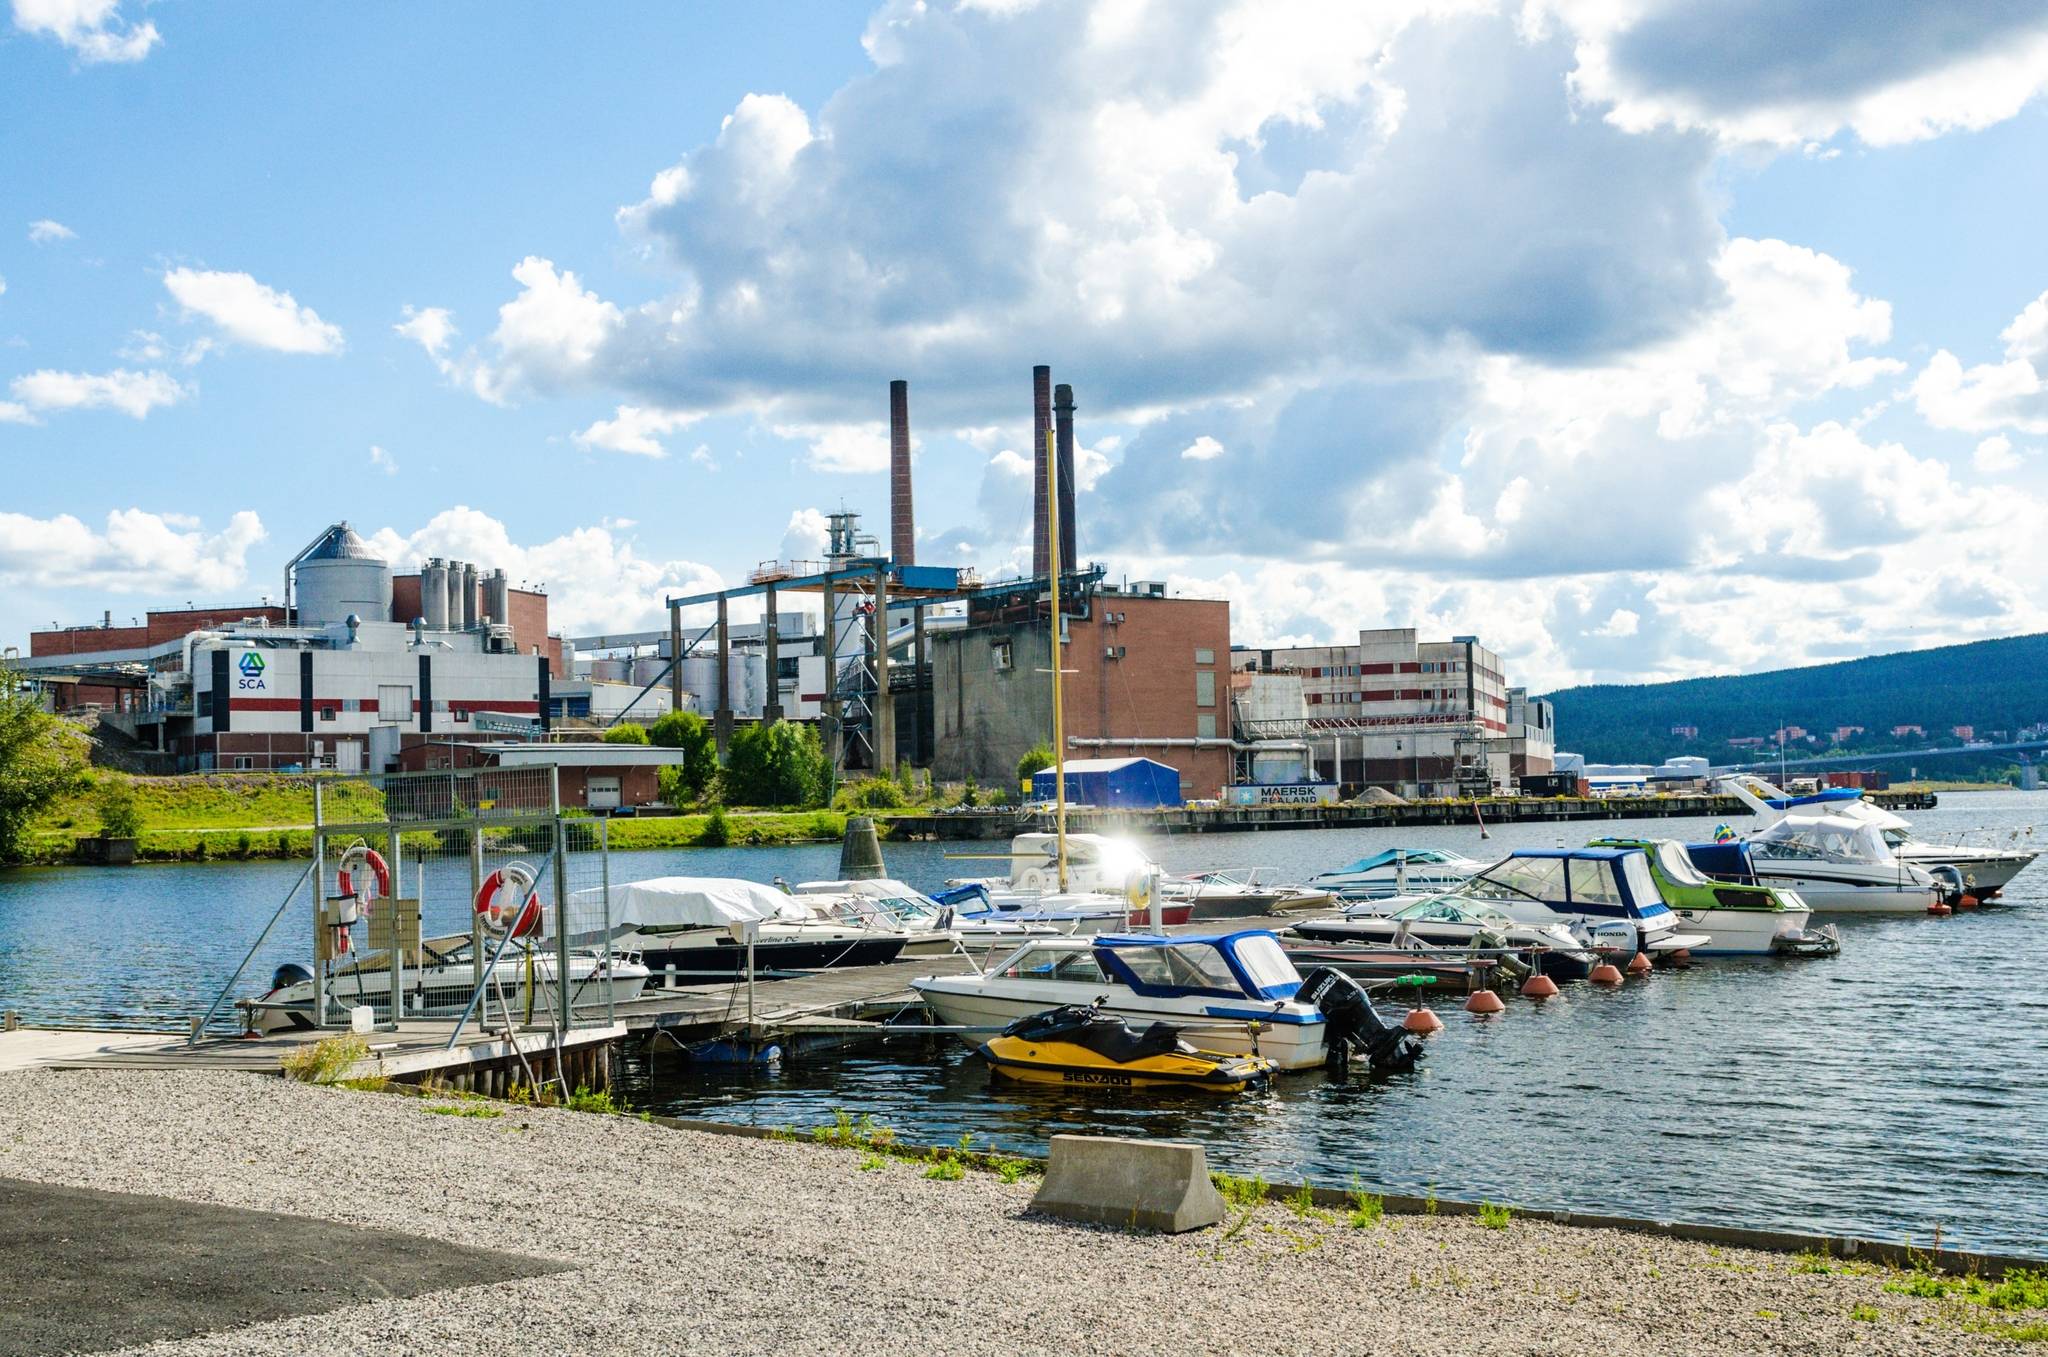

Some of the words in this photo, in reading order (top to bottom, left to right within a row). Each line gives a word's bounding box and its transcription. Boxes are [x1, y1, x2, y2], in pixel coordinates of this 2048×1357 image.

[239, 679, 266, 690] SCA
[1261, 787, 1316, 797] MAERSK
[1310, 973, 1335, 1000] SUZUKI
